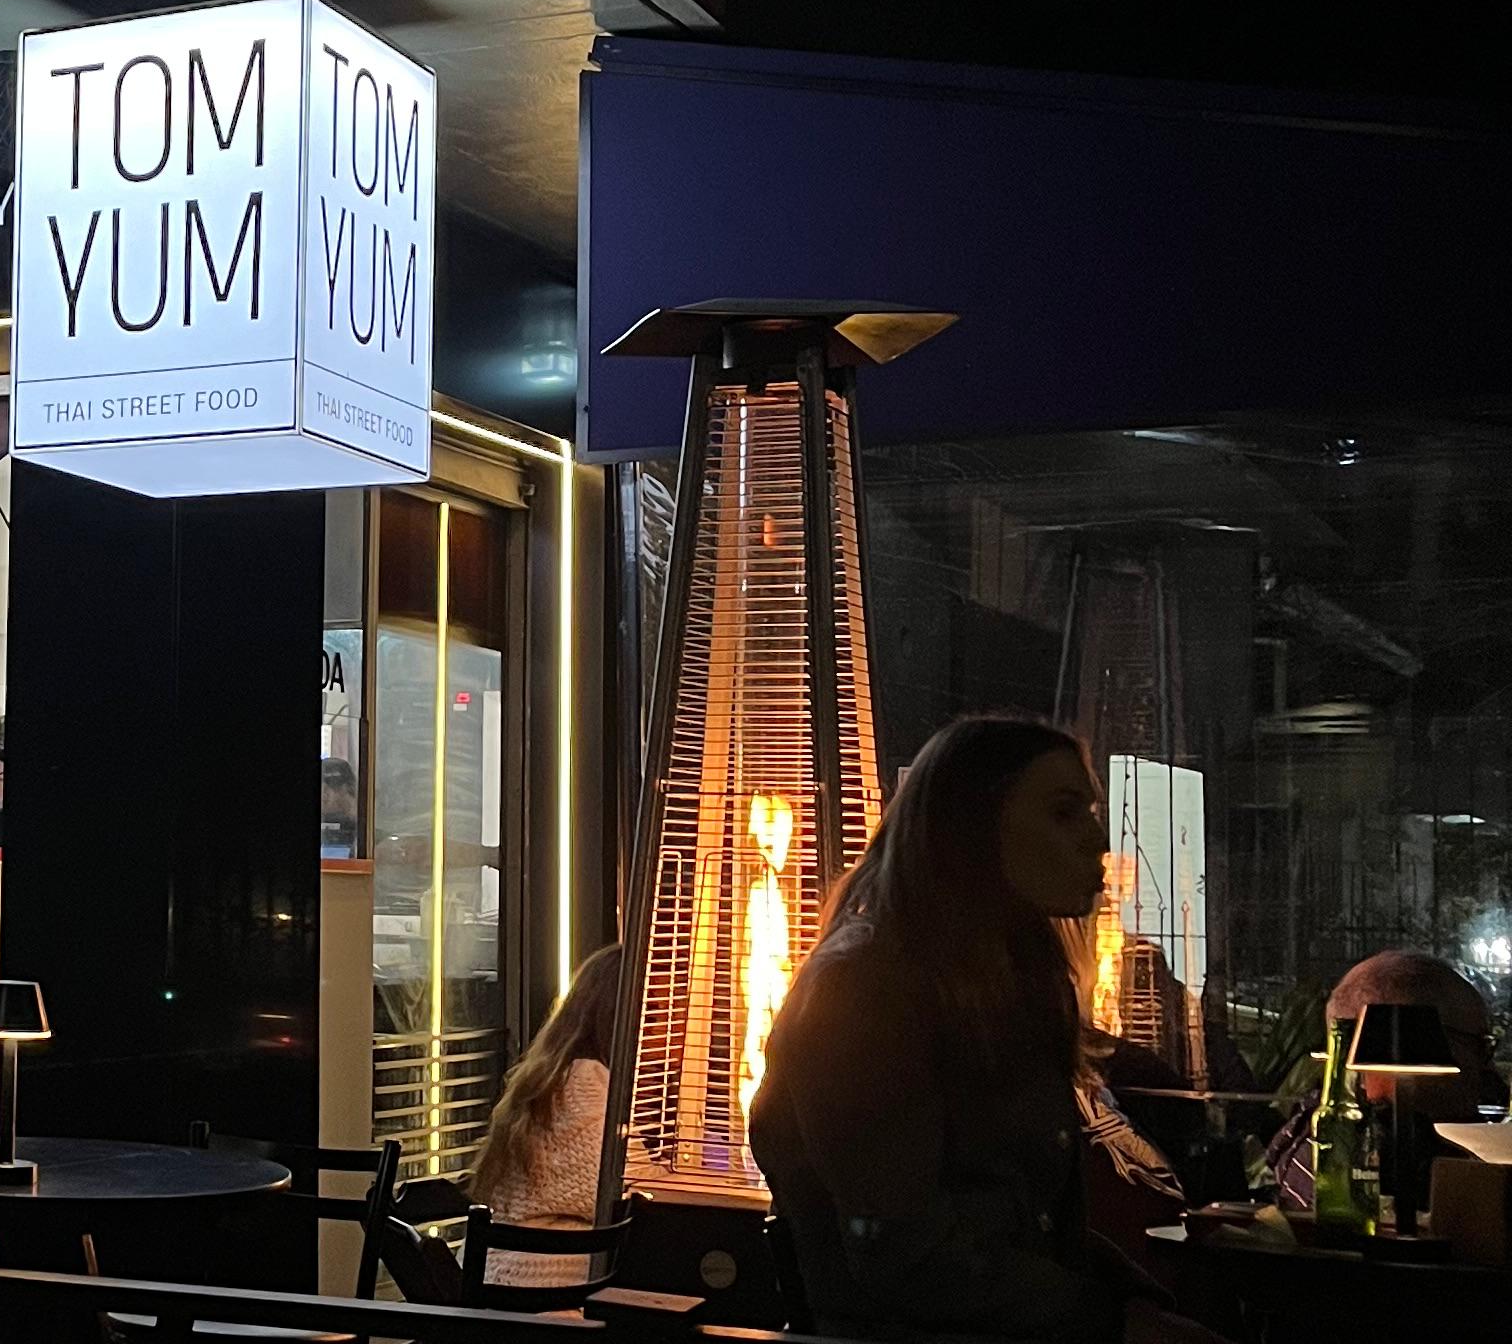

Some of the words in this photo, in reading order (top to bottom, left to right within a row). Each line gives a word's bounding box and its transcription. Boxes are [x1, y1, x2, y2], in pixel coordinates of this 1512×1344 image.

[51, 39, 266, 189] TOM
[323, 43, 419, 221] TOM
[47, 191, 264, 338] YUM
[321, 195, 417, 365] YUM
[43, 400, 92, 423] THAI
[101, 392, 186, 420] STREET
[194, 387, 258, 412] FOOD
[317, 391, 341, 420] THAI
[344, 402, 383, 435] STREET
[385, 419, 413, 447] FOOD
